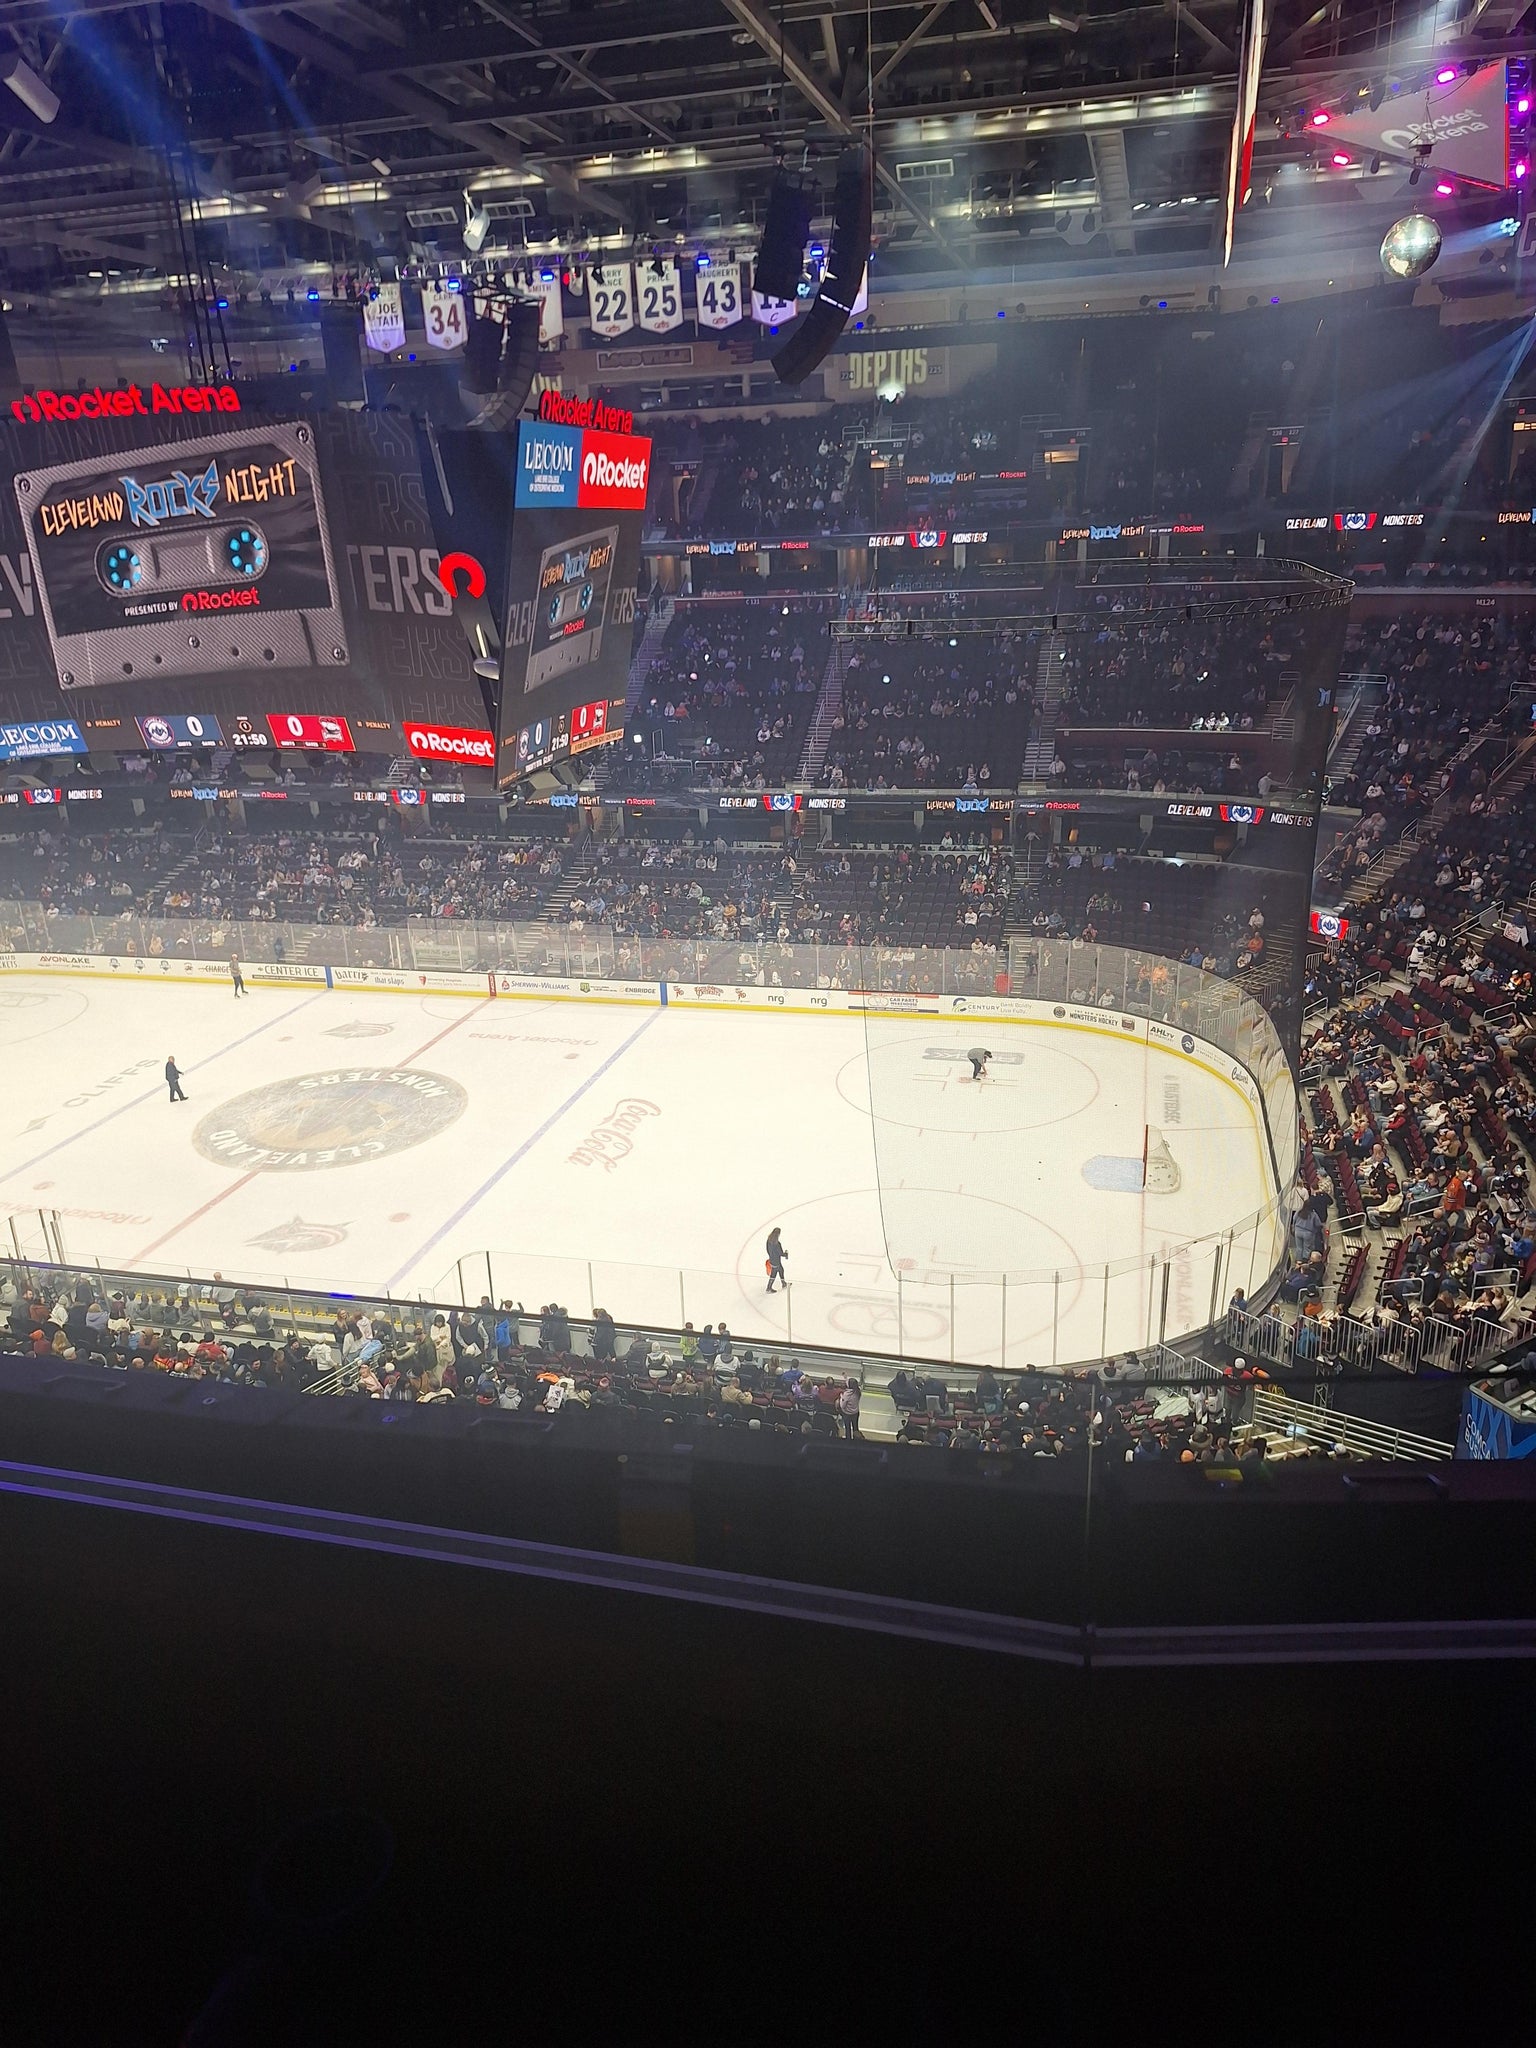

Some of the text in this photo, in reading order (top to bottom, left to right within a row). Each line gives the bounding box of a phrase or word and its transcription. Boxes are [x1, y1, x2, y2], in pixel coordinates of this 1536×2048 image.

[1407, 109, 1482, 134] Rocket
[1425, 121, 1489, 143] Arena
[595, 289, 628, 322] 22
[643, 285, 677, 318] 25
[702, 280, 736, 314] 43
[379, 303, 397, 314] JOE
[430, 303, 461, 335] 34
[377, 314, 399, 327] TAIT
[850, 348, 928, 389] DEPTHS
[36, 382, 241, 421] Rocket Arena
[551, 391, 634, 433] Rocket Arena
[525, 440, 573, 474] LECOM
[597, 453, 646, 489] Rocket
[40, 458, 296, 536] CLEVELAND ROCKS NIGHT
[1286, 514, 1424, 530] CLEVELAND MONSTERS
[1498, 511, 1531, 524] CLEVELAND
[868, 532, 988, 547] CLEVELAND MONSTERS
[1121, 526, 1146, 537] NIGHT
[1180, 525, 1205, 533] Rocket
[787, 542, 809, 550] Rocket
[125, 586, 260, 617] PRESENTED BY Rocket
[1476, 598, 1496, 606] M124
[186, 715, 204, 737] 0
[287, 715, 304, 737] 0
[580, 707, 587, 728] 0
[232, 733, 268, 746] 21:50
[535, 722, 543, 745] 0
[552, 733, 569, 752] 21:50
[427, 732, 494, 759] Rocket
[68, 789, 103, 800] MONSTERS
[266, 791, 288, 799] Rocket
[353, 791, 466, 803] CLEVELAND MONSTERS
[579, 796, 601, 806] NIGHT
[633, 798, 656, 806] Rocket
[719, 797, 846, 809] CLEVELAND MONSTERS
[990, 799, 1014, 810] NIGHT
[1053, 801, 1081, 810] Rocket
[1167, 804, 1314, 827] CLEVELAND MONSTERS
[40, 955, 90, 964] AVONLAKE
[264, 965, 319, 977] CENTER ICE
[388, 977, 405, 986] slaps
[768, 994, 785, 1005] nrg
[811, 997, 828, 1007] nrg
[1070, 1012, 1097, 1022] MONSTERS
[1098, 1017, 1119, 1027] HOCKEY
[62, 1058, 161, 1108] CLIFFS
[297, 1071, 449, 1098] MONSTERS
[209, 1128, 386, 1166] CLEVELAND
[1466, 1413, 1494, 1460] COMCA
